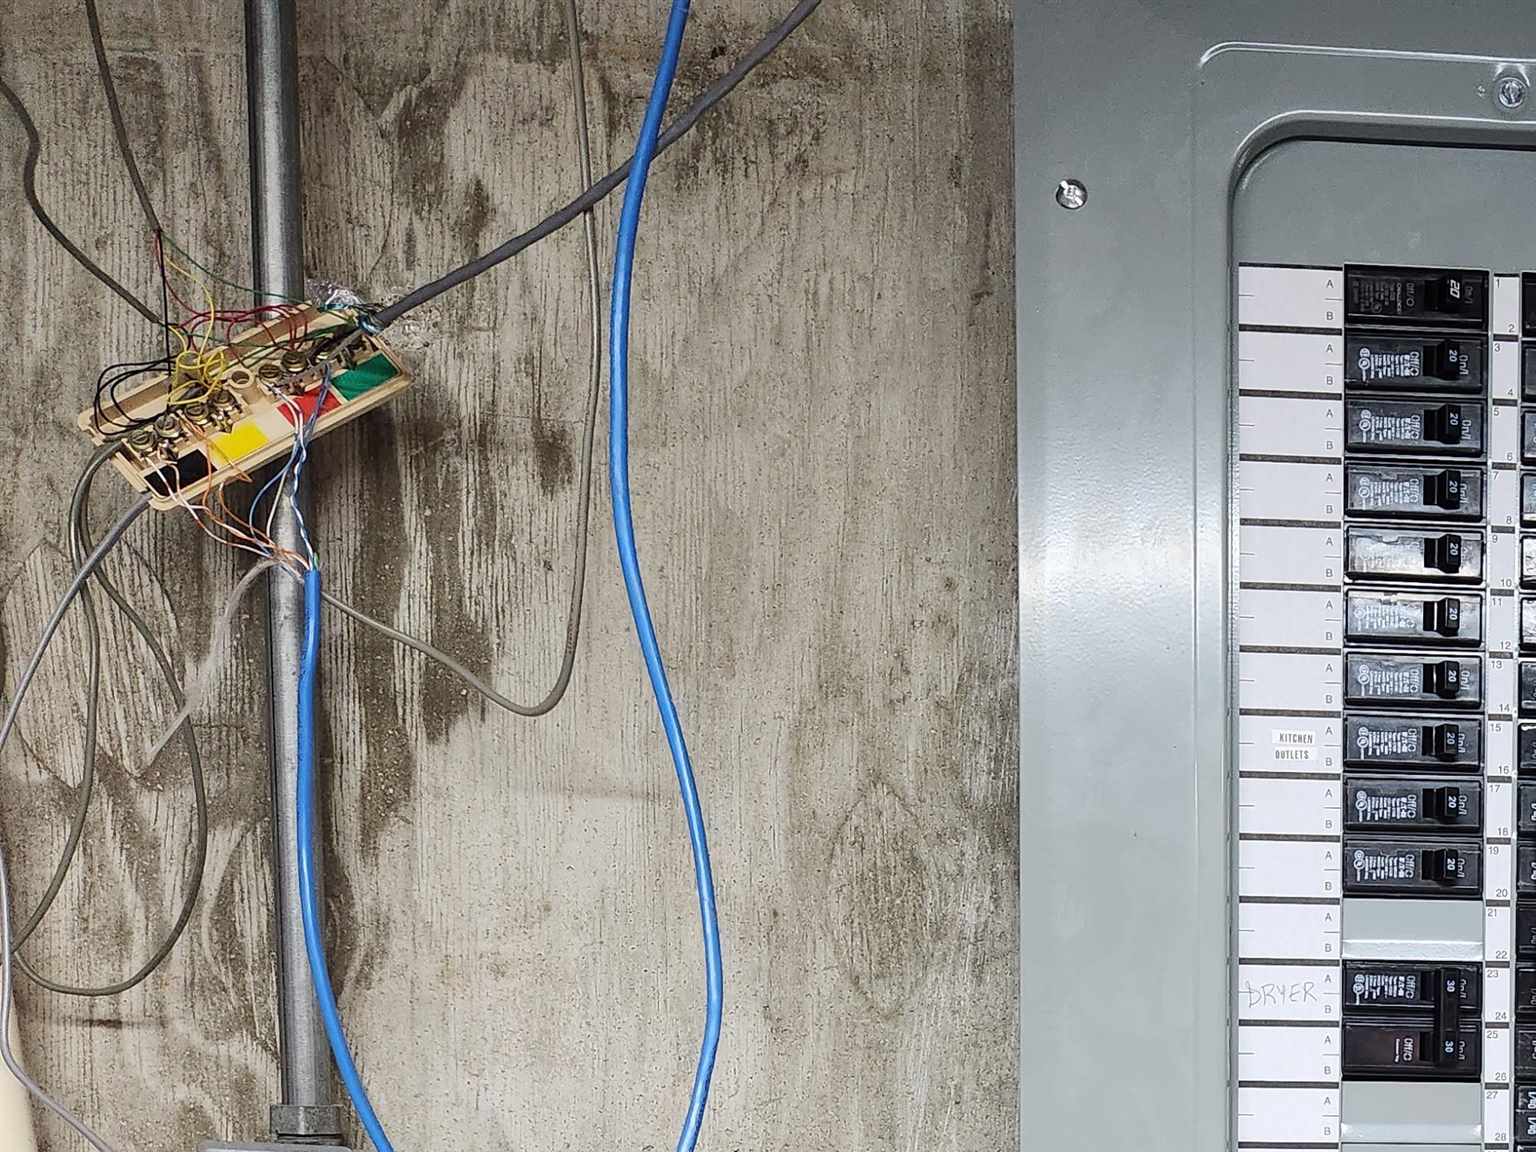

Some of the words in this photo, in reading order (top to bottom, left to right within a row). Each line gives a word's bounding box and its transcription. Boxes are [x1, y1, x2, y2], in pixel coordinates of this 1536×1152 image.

[1450, 280, 1460, 297] 20
[1449, 350, 1456, 362] 20
[1450, 413, 1457, 426] 20
[1449, 480, 1457, 493] 20
[1449, 543, 1457, 556] 20
[1449, 608, 1457, 620] 20
[1499, 704, 1511, 713] 14
[1280, 732, 1313, 744] KITCHEN
[1447, 732, 1455, 745] 20
[1275, 749, 1309, 760] OUTLETS
[1498, 764, 1510, 774] 16
[1498, 826, 1510, 836] 18
[1488, 846, 1499, 855] 19
[1496, 888, 1509, 898] 20
[1487, 908, 1497, 917] 21
[1496, 950, 1508, 959] 22
[1447, 980, 1455, 992] 30
[1245, 980, 1318, 1008] DRYER
[1495, 1011, 1507, 1020] 24
[1486, 1030, 1498, 1040] 25
[1445, 1041, 1453, 1053] 30
[1494, 1072, 1507, 1081] 26
[1494, 1132, 1507, 1141] 28
